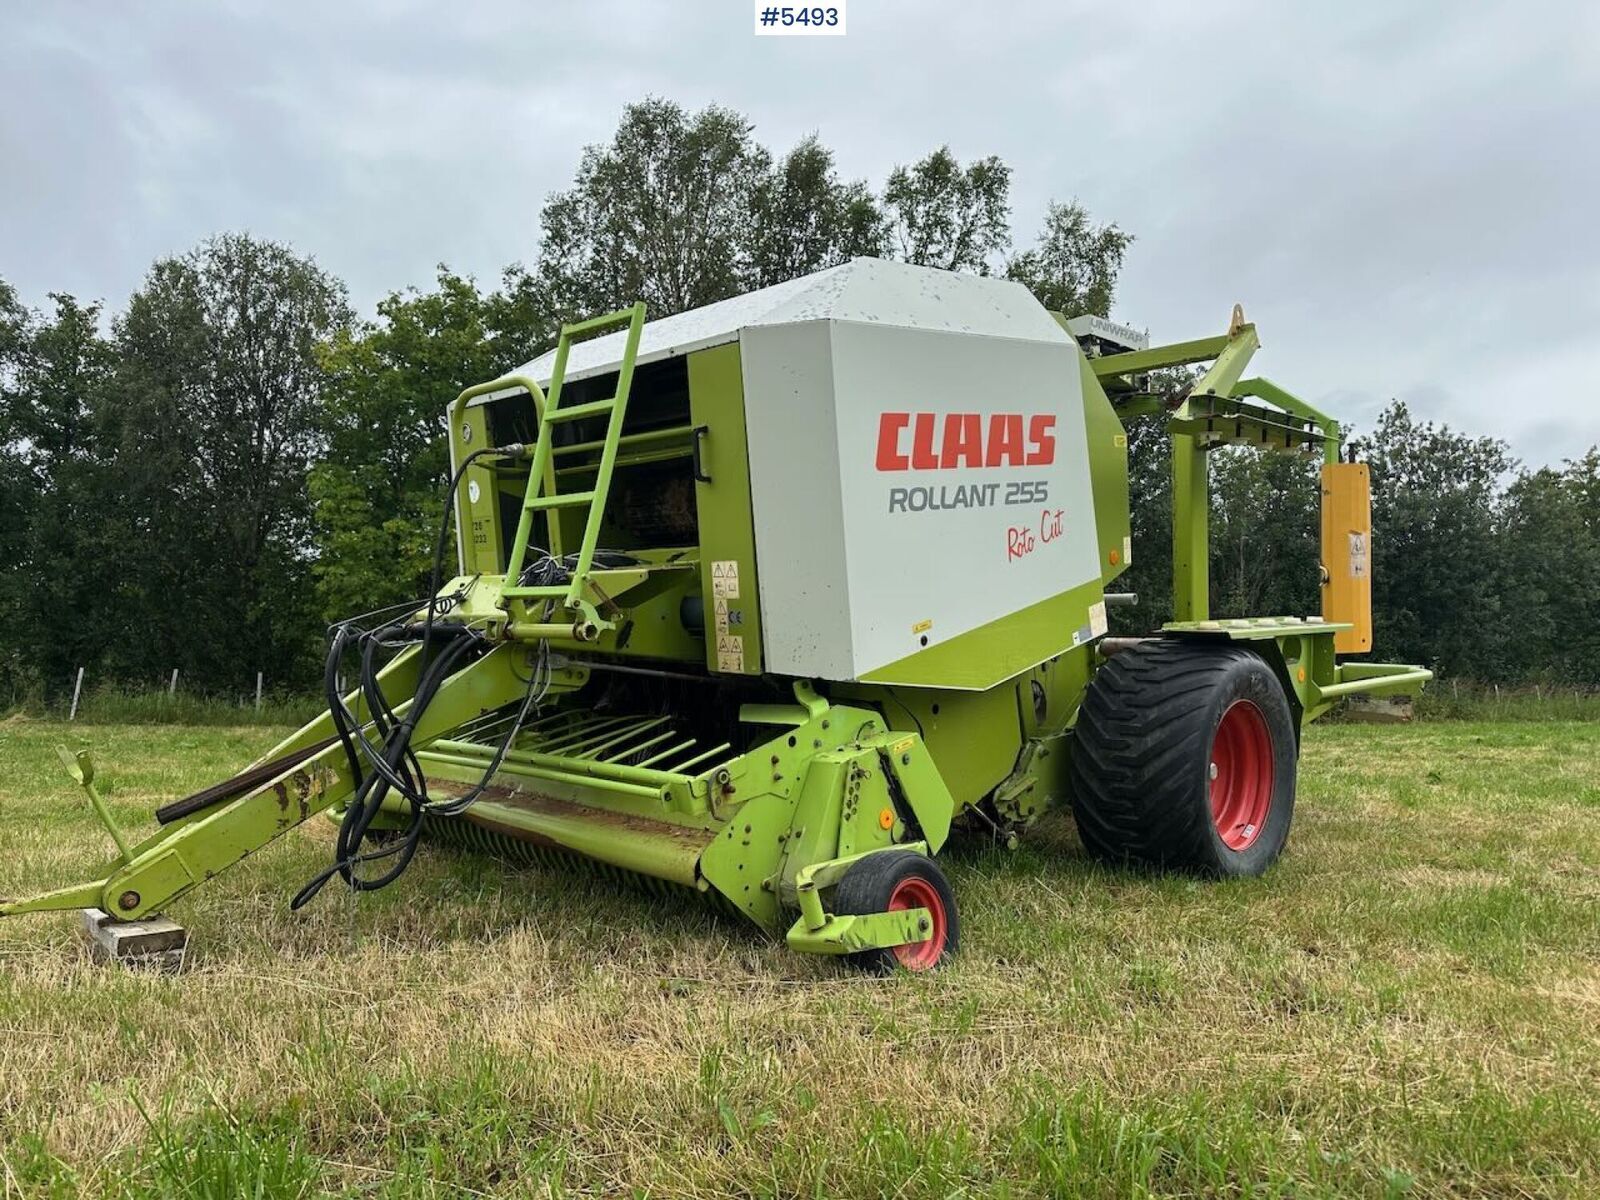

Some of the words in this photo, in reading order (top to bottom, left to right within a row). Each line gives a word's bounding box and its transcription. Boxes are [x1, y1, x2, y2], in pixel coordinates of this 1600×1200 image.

[876, 413, 1056, 471] CLAAS
[889, 484, 1000, 513] ROLLANT
[1005, 481, 1048, 505] 255
[1007, 526, 1034, 563] Roto
[1041, 509, 1064, 543] Cut
